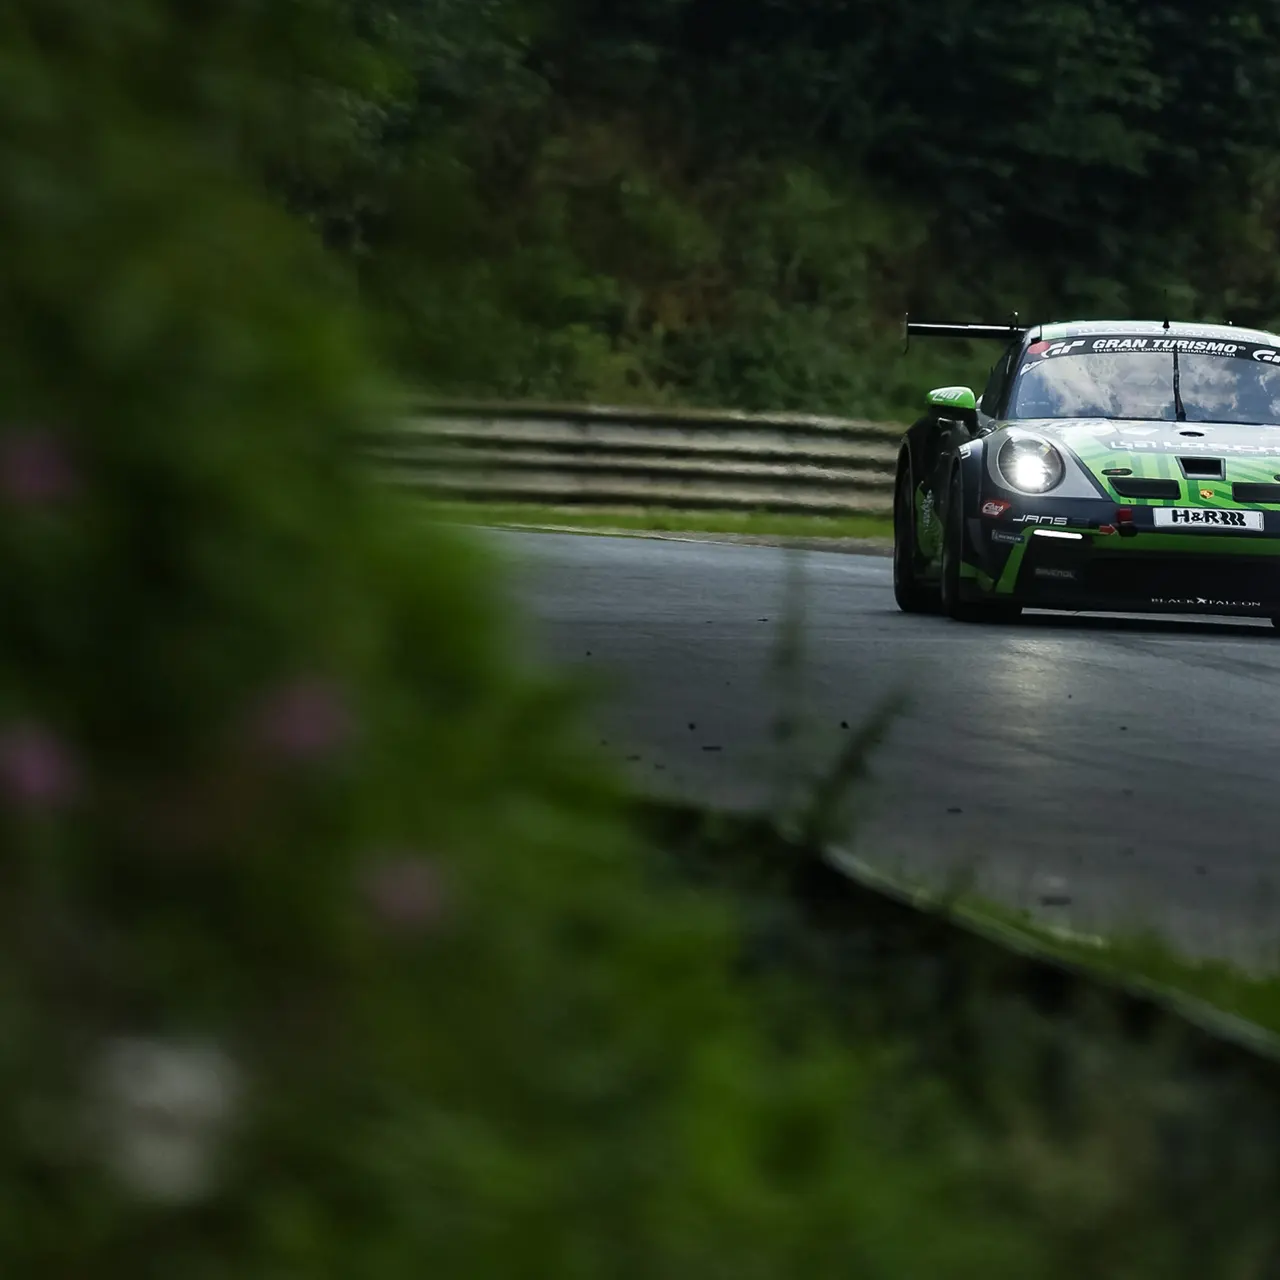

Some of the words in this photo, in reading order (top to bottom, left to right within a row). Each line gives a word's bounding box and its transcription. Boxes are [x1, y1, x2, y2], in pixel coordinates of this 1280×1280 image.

[1092, 339, 1148, 349] GRAN
[1152, 339, 1238, 353] TURISMO
[1013, 515, 1068, 526] JANS
